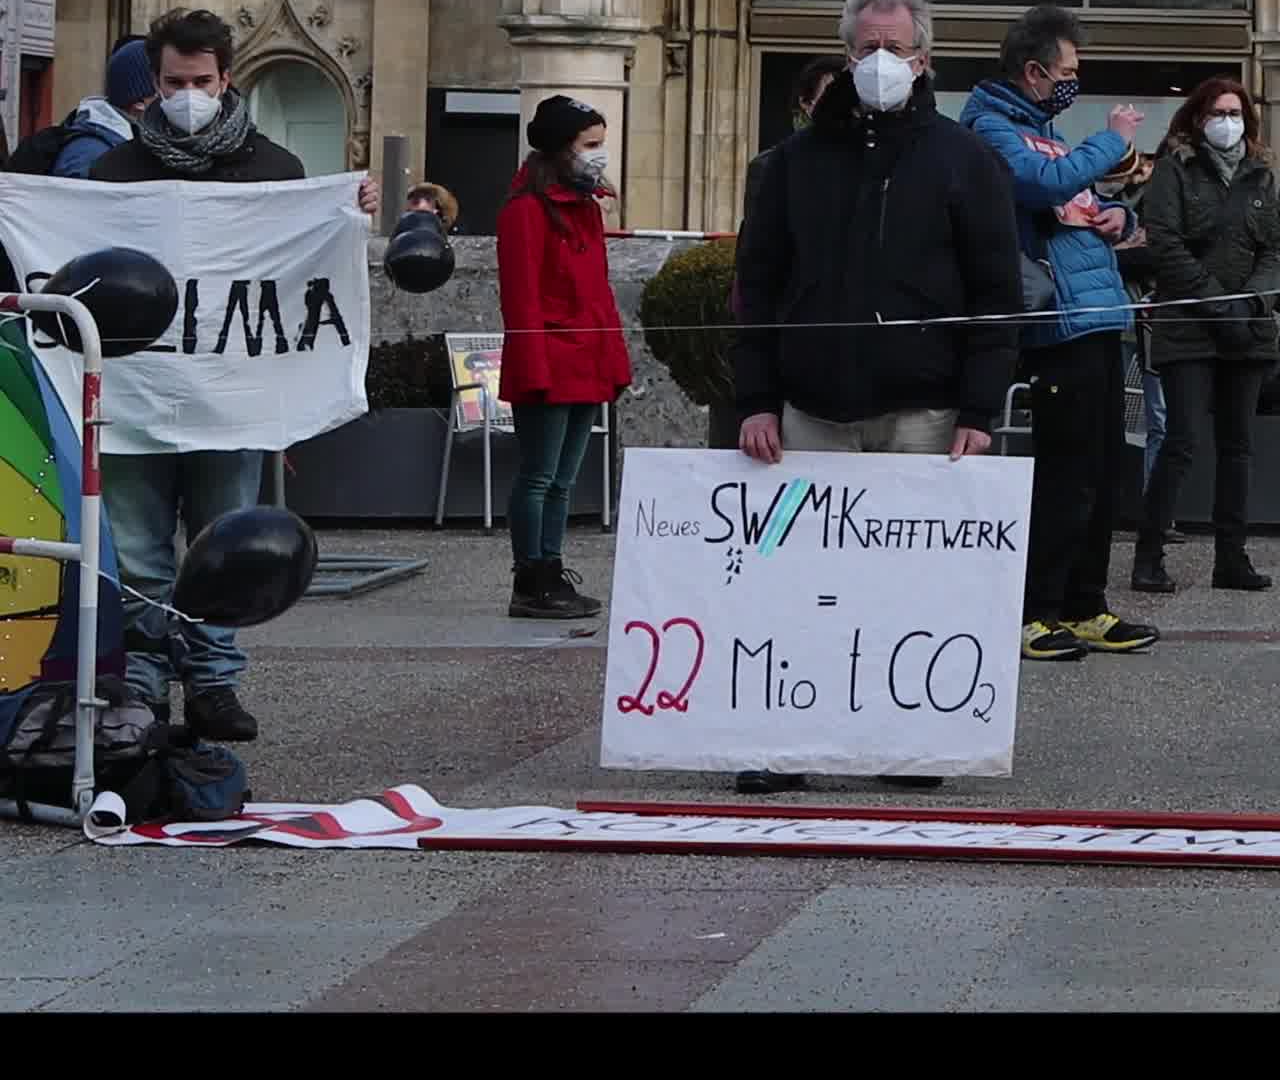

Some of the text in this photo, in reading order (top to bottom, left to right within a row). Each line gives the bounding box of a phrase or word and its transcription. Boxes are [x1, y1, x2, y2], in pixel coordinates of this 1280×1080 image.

[636, 498, 701, 538] Neues
[616, 617, 705, 715] 22
[731, 637, 817, 711] Mio
[848, 628, 862, 713] t
